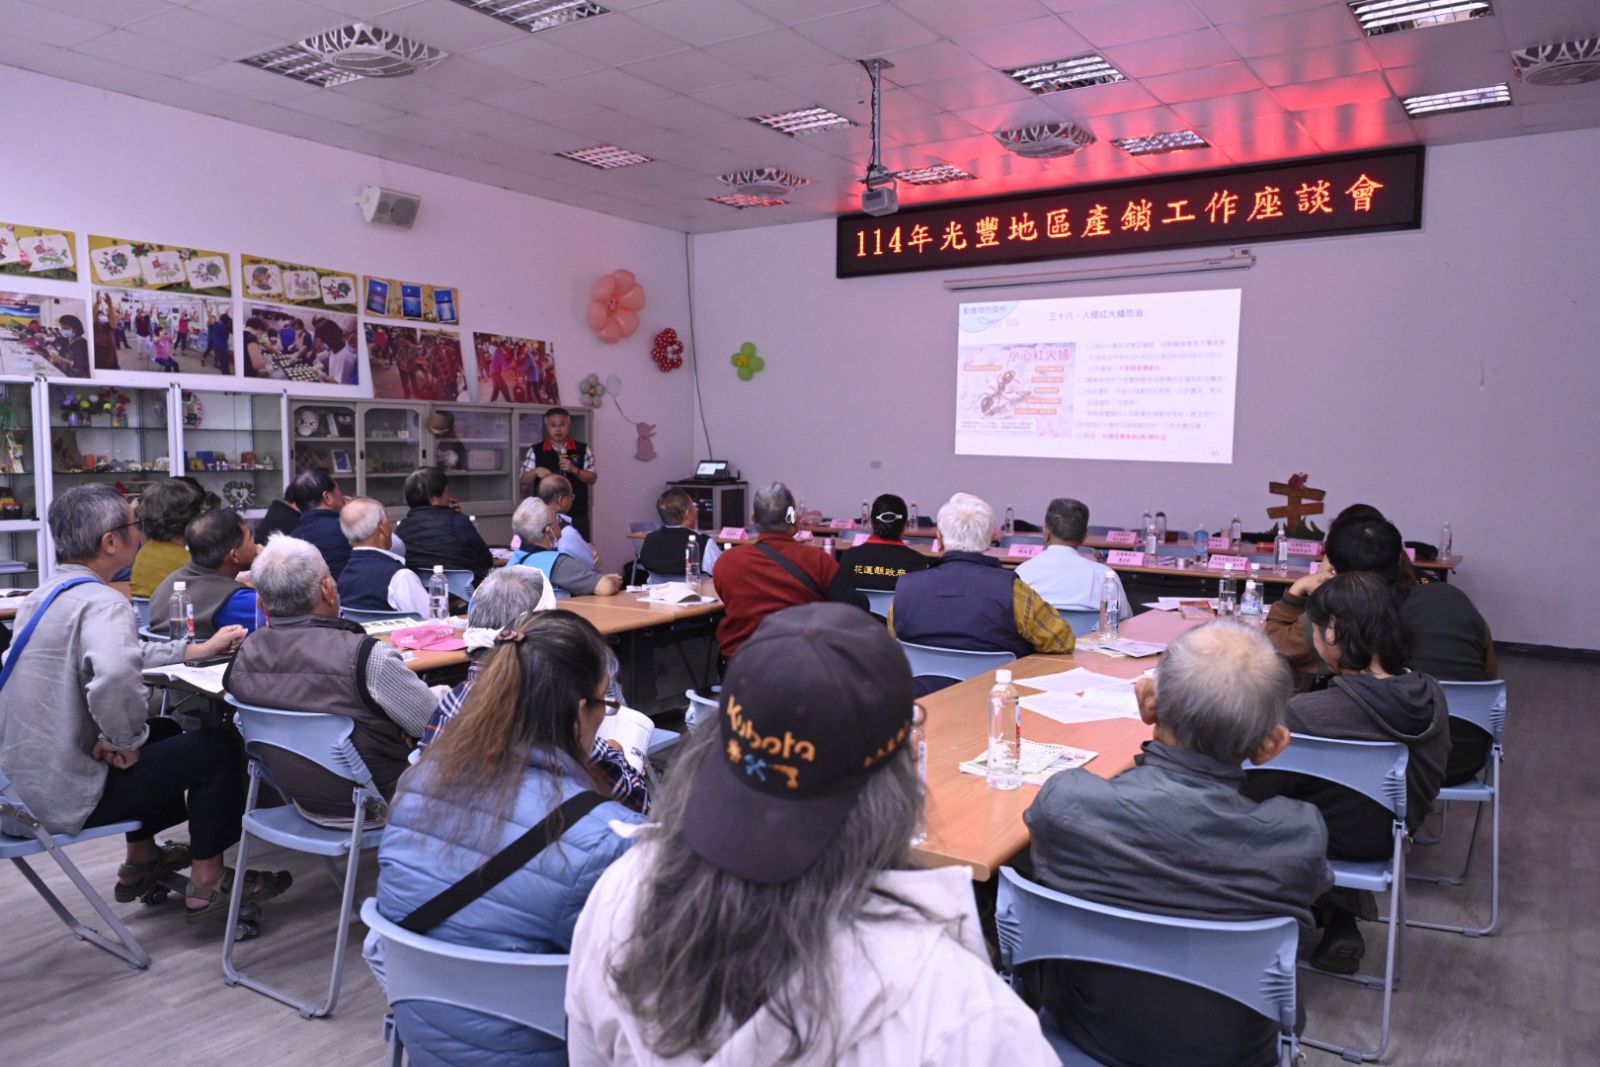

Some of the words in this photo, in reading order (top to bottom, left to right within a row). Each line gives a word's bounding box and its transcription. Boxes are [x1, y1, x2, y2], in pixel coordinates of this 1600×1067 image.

[856, 172, 1384, 257] 114年光豐地區產銷工作座談會
